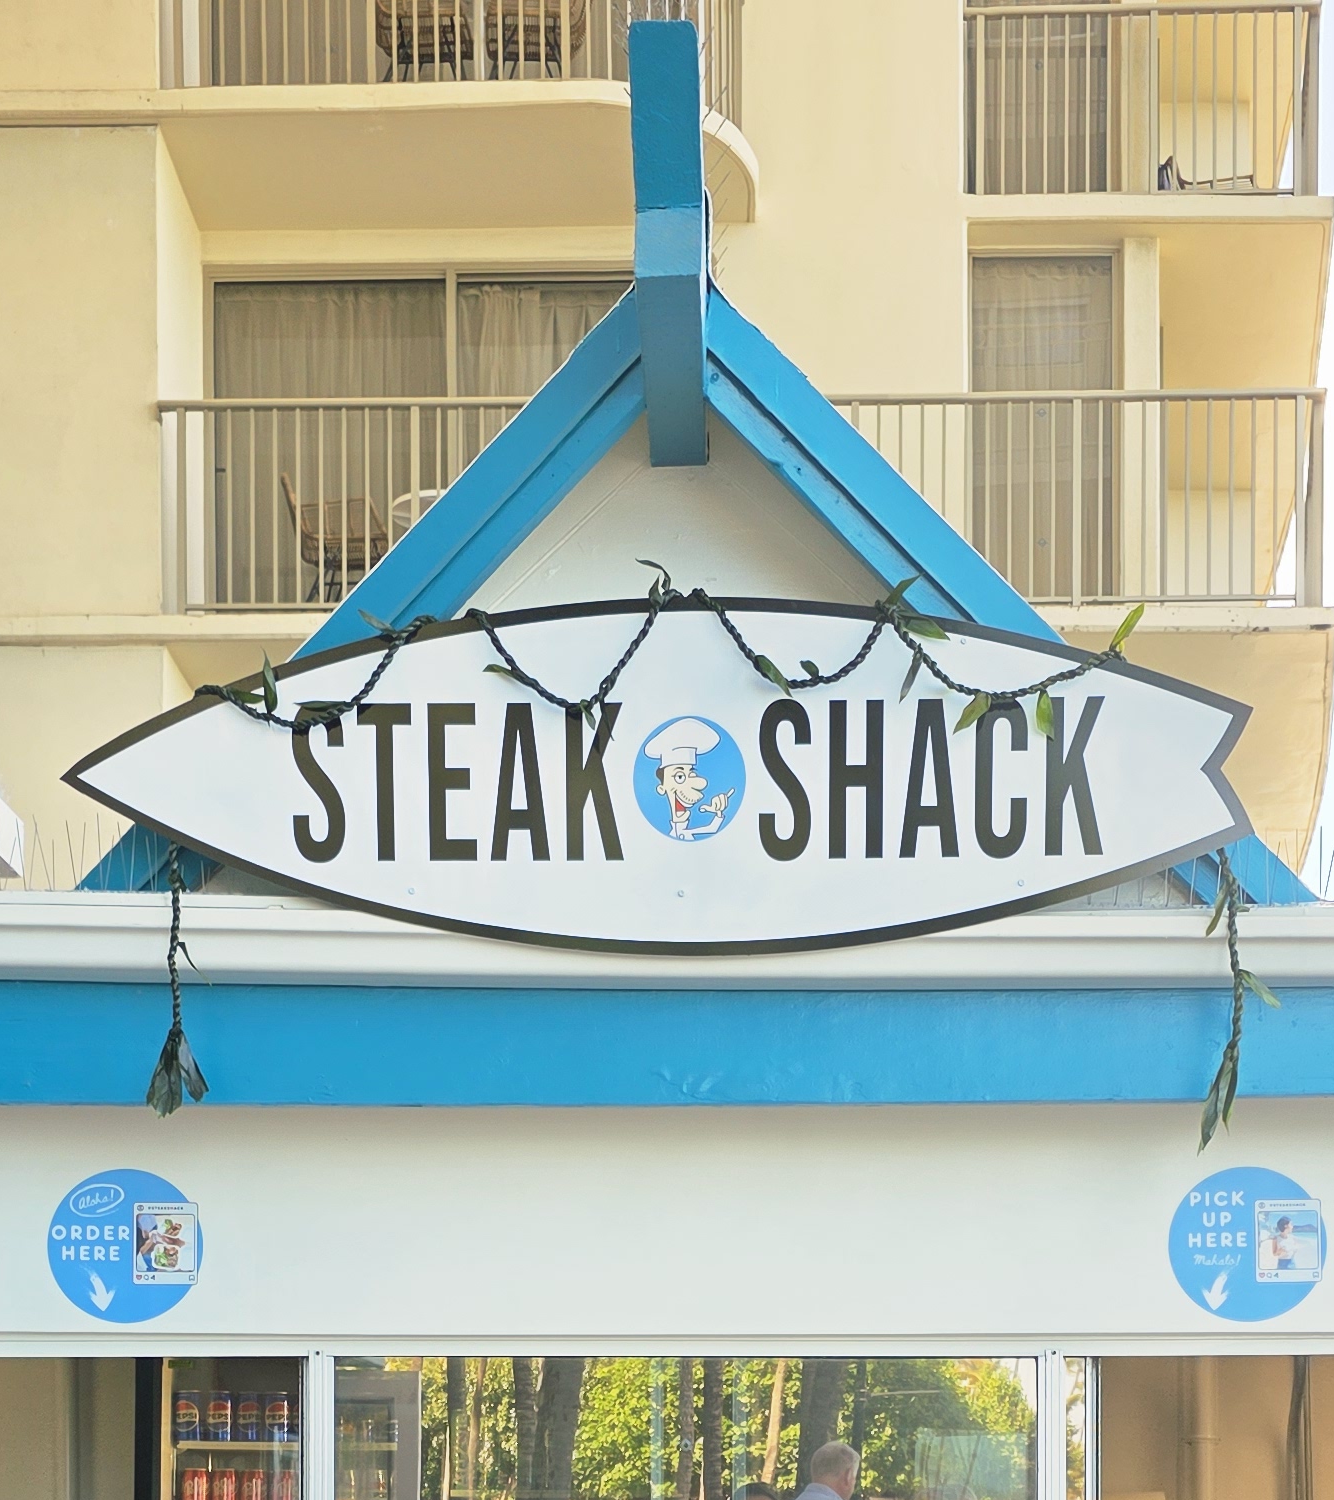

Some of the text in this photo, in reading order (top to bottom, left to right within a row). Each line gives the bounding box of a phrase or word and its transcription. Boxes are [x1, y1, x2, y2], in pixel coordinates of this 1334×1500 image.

[292, 695, 1103, 861] STEAK SHACK
[79, 1189, 115, 1209] Aloha!
[1189, 1191, 1245, 1207] PICK
[1203, 1212, 1232, 1227] UP
[52, 1225, 130, 1241] ORDER
[1188, 1232, 1247, 1248] HERE
[62, 1246, 120, 1261] HERE
